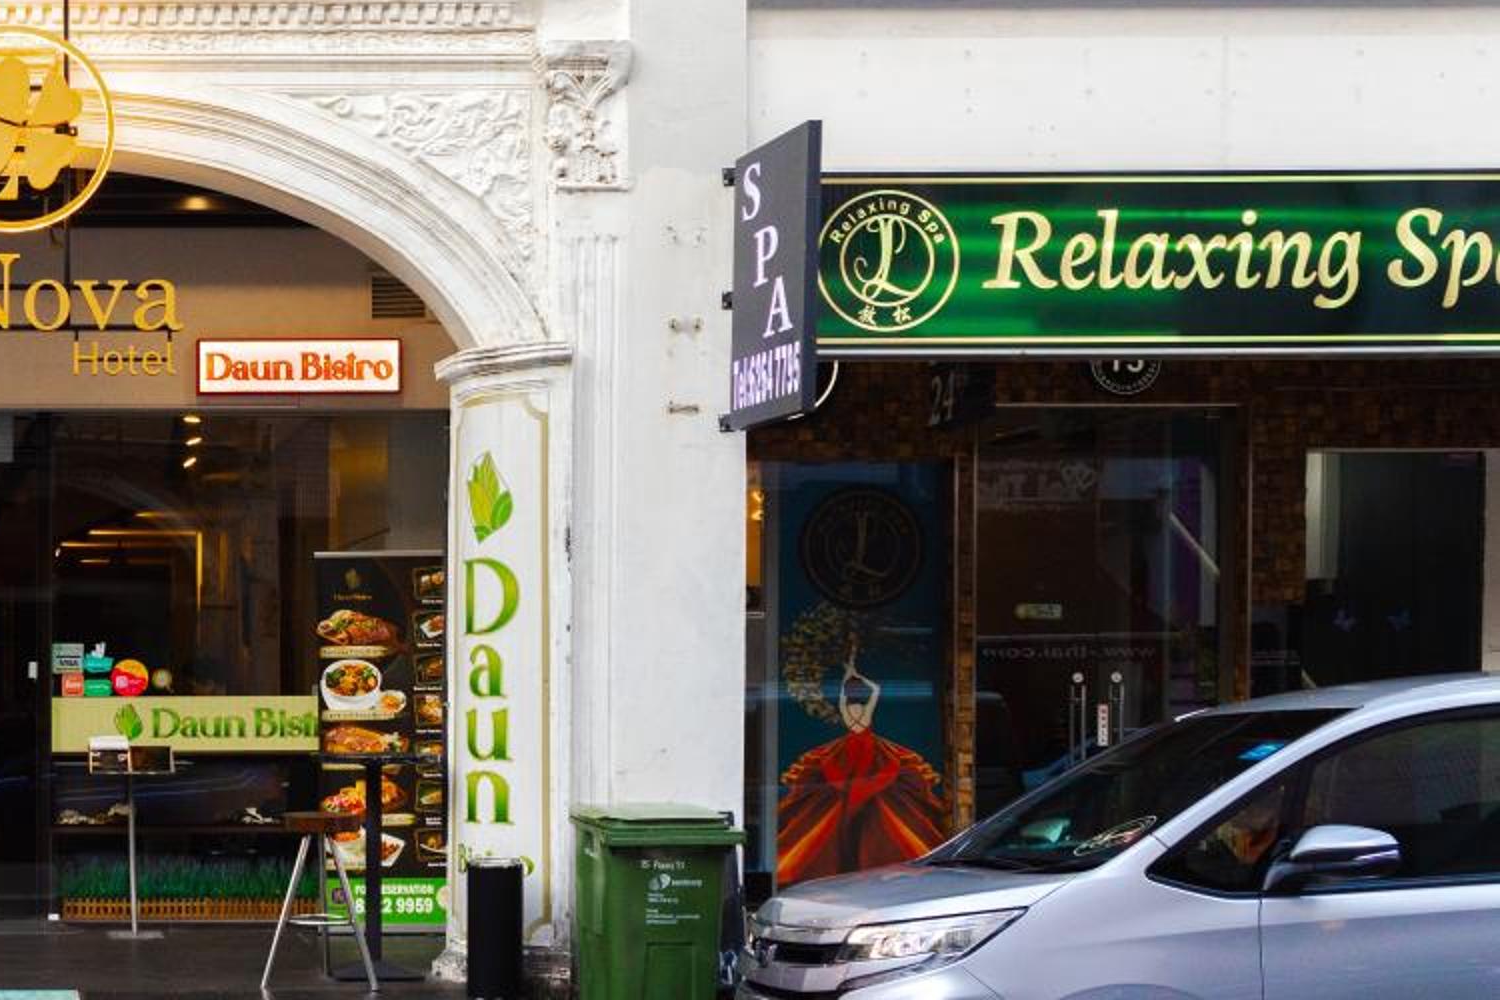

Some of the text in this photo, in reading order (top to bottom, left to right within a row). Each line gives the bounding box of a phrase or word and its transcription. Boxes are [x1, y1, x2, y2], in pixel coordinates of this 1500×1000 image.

[830, 198, 945, 244] Relaxing Spa
[981, 207, 1500, 309] Relaxing Sp
[72, 340, 176, 377] Hotel
[205, 351, 394, 382] Daun Bistro
[463, 557, 520, 825] Daun
[151, 708, 245, 738] Daun
